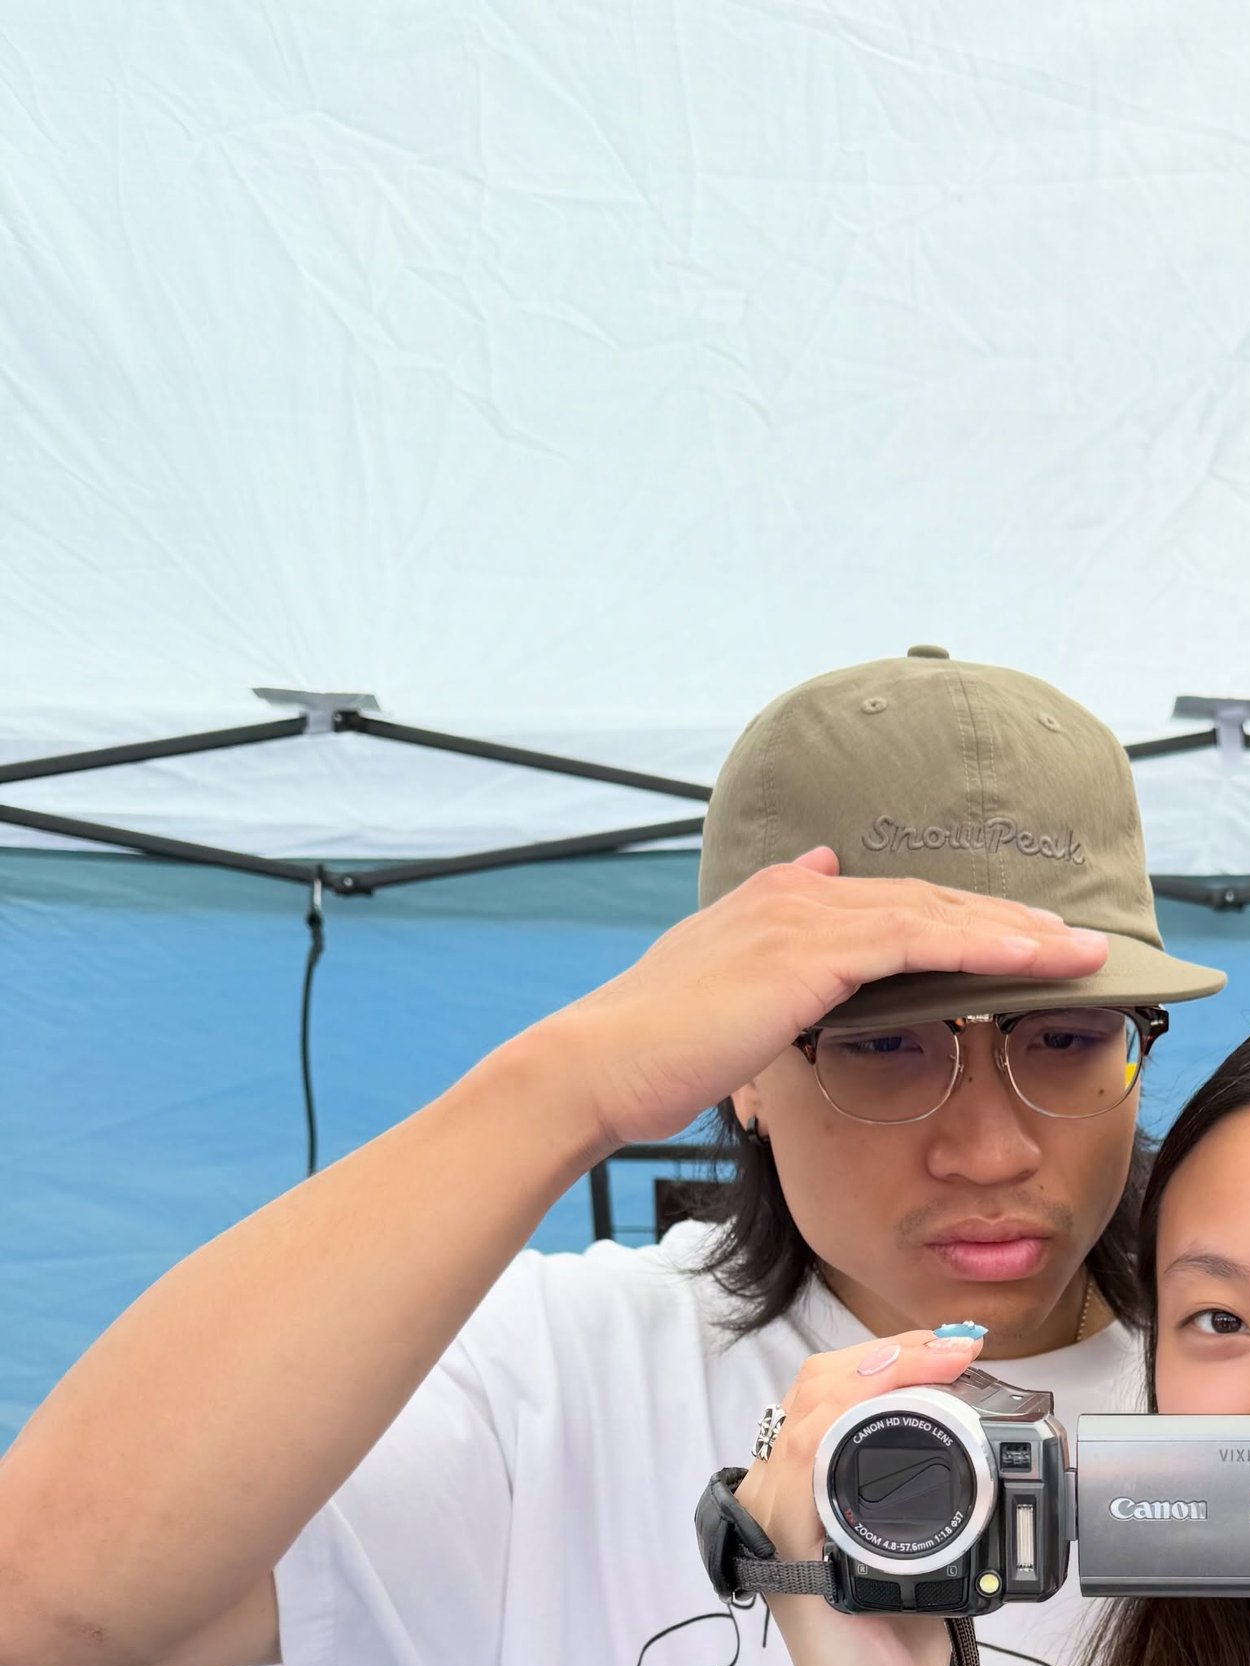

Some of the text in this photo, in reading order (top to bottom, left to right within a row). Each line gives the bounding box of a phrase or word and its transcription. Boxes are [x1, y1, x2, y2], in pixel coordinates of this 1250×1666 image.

[852, 1417, 954, 1447] CANON HD VIDEO LENS
[1109, 1497, 1208, 1521] Canon
[854, 1523, 882, 1546] ZOOM
[882, 1540, 934, 1552] 4.8-57.6mm
